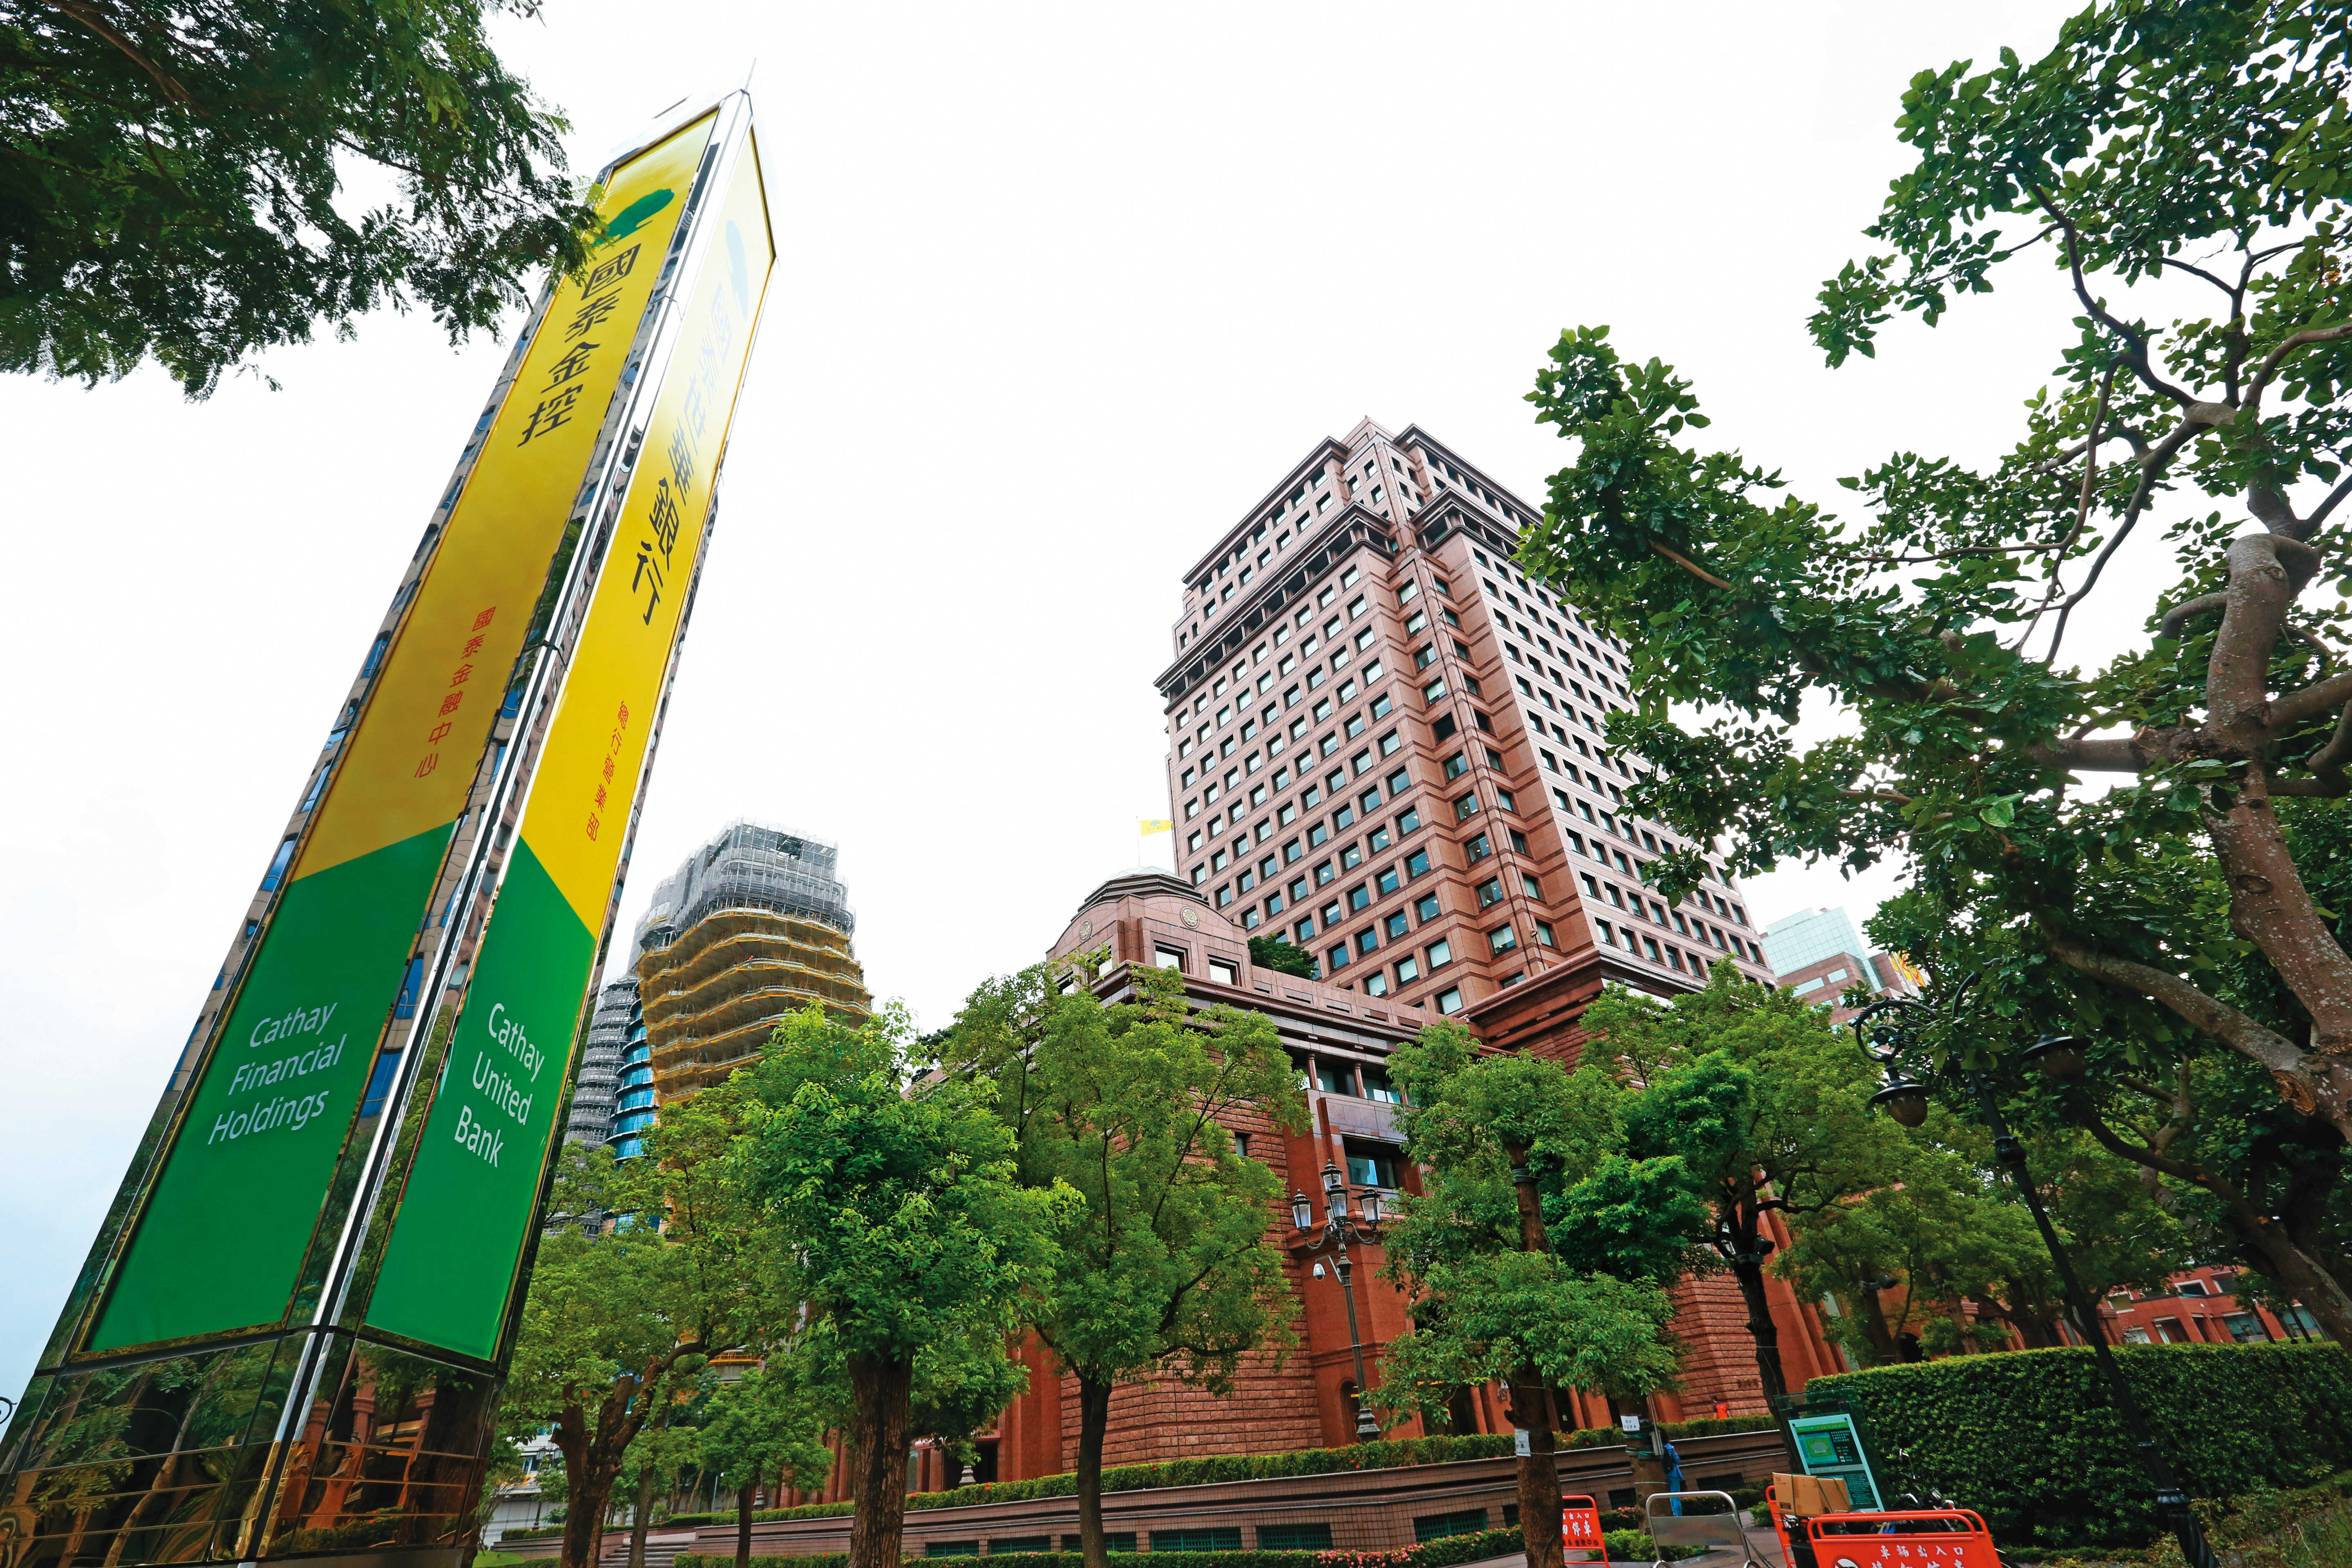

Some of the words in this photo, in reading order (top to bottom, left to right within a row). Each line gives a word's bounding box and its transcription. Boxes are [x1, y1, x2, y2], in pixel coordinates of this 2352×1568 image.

[517, 243, 641, 448] 國泰金控
[632, 282, 732, 626] 國泰世華銀行
[414, 606, 496, 778] 國泰金融中心
[586, 700, 629, 842] 總行營業部
[250, 1002, 337, 1047] Cathay
[489, 1003, 545, 1083] Cathay
[228, 1033, 347, 1096] Financial
[473, 1051, 533, 1125] United
[208, 1091, 329, 1145] Holdings
[454, 1105, 504, 1168] Bank
[1880, 1544, 1964, 1560] 車輛出入口
